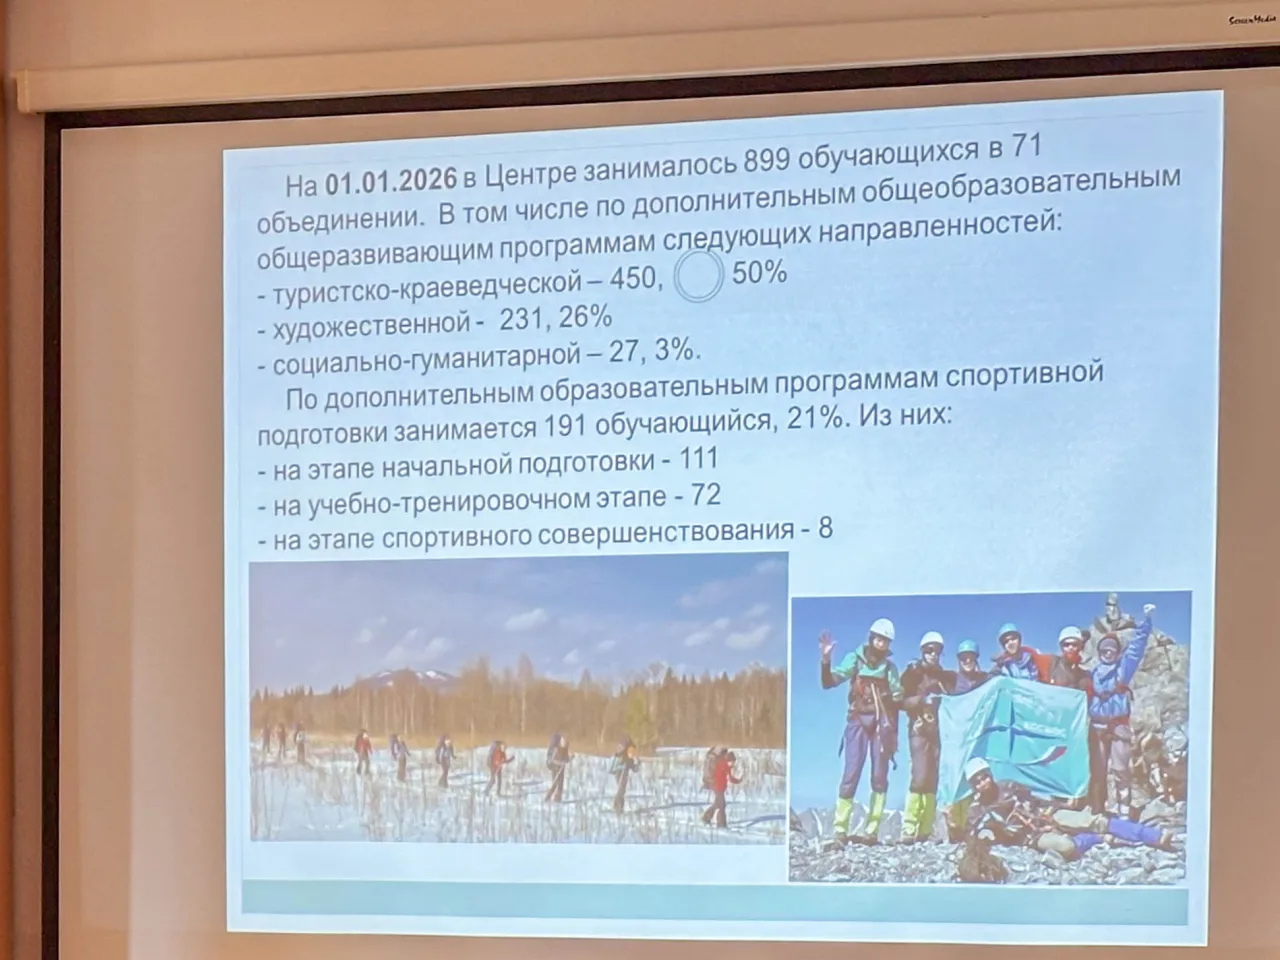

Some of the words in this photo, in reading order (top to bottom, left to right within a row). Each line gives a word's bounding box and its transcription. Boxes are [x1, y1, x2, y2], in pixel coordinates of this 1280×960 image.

[286, 174, 318, 198] На
[325, 165, 458, 197] 01.01.2026
[463, 170, 477, 189] в
[485, 162, 578, 193] Центре
[583, 155, 739, 183] занималось
[743, 146, 791, 174] 899
[797, 141, 981, 176] обучающихся
[988, 140, 1004, 161] в
[1011, 131, 1040, 158] 71
[256, 208, 426, 237] объединении.
[439, 201, 456, 226] В
[461, 204, 508, 225] том
[514, 199, 590, 222] числе
[596, 197, 626, 218] по
[631, 180, 856, 221] дополнительным
[860, 164, 1181, 206] общеобразовательным
[257, 240, 494, 275] общеразвивающим
[499, 232, 656, 263] программам
[662, 223, 813, 255] следующих
[818, 206, 1062, 247] направленностей:
[272, 269, 582, 309] туристско-краеведческой
[609, 264, 663, 293] 450,
[732, 257, 788, 285] 50%
[272, 314, 471, 346] художественной
[499, 305, 552, 333] 231,
[558, 302, 613, 329] 26%
[273, 340, 581, 380] социально-гуманитарной
[608, 338, 647, 367] 27,
[654, 335, 701, 362] 3%.
[286, 386, 319, 411] По
[323, 384, 535, 415] дополнительным
[539, 376, 769, 410] образовательным
[774, 366, 939, 398] программам
[945, 357, 1104, 393] спортивной
[258, 424, 389, 451] подготовки
[393, 420, 538, 443] занимается
[544, 412, 585, 438] 191
[595, 406, 779, 442] обучающийся,
[787, 402, 851, 430] 21%.
[859, 401, 893, 428] Из
[900, 401, 953, 426] них:
[273, 463, 302, 482] на
[307, 460, 376, 481] этапе
[382, 450, 513, 479] начальной
[518, 452, 655, 479] подготовки
[679, 444, 717, 470] 111
[274, 497, 302, 517] на
[307, 490, 591, 522] учебно-тренировочном
[595, 488, 668, 509] этапе
[690, 481, 722, 507] 72
[273, 533, 302, 551] на
[308, 531, 376, 551] этапе
[381, 527, 533, 554] спортивного
[537, 522, 795, 551] совершенствования
[818, 515, 834, 539] 8
